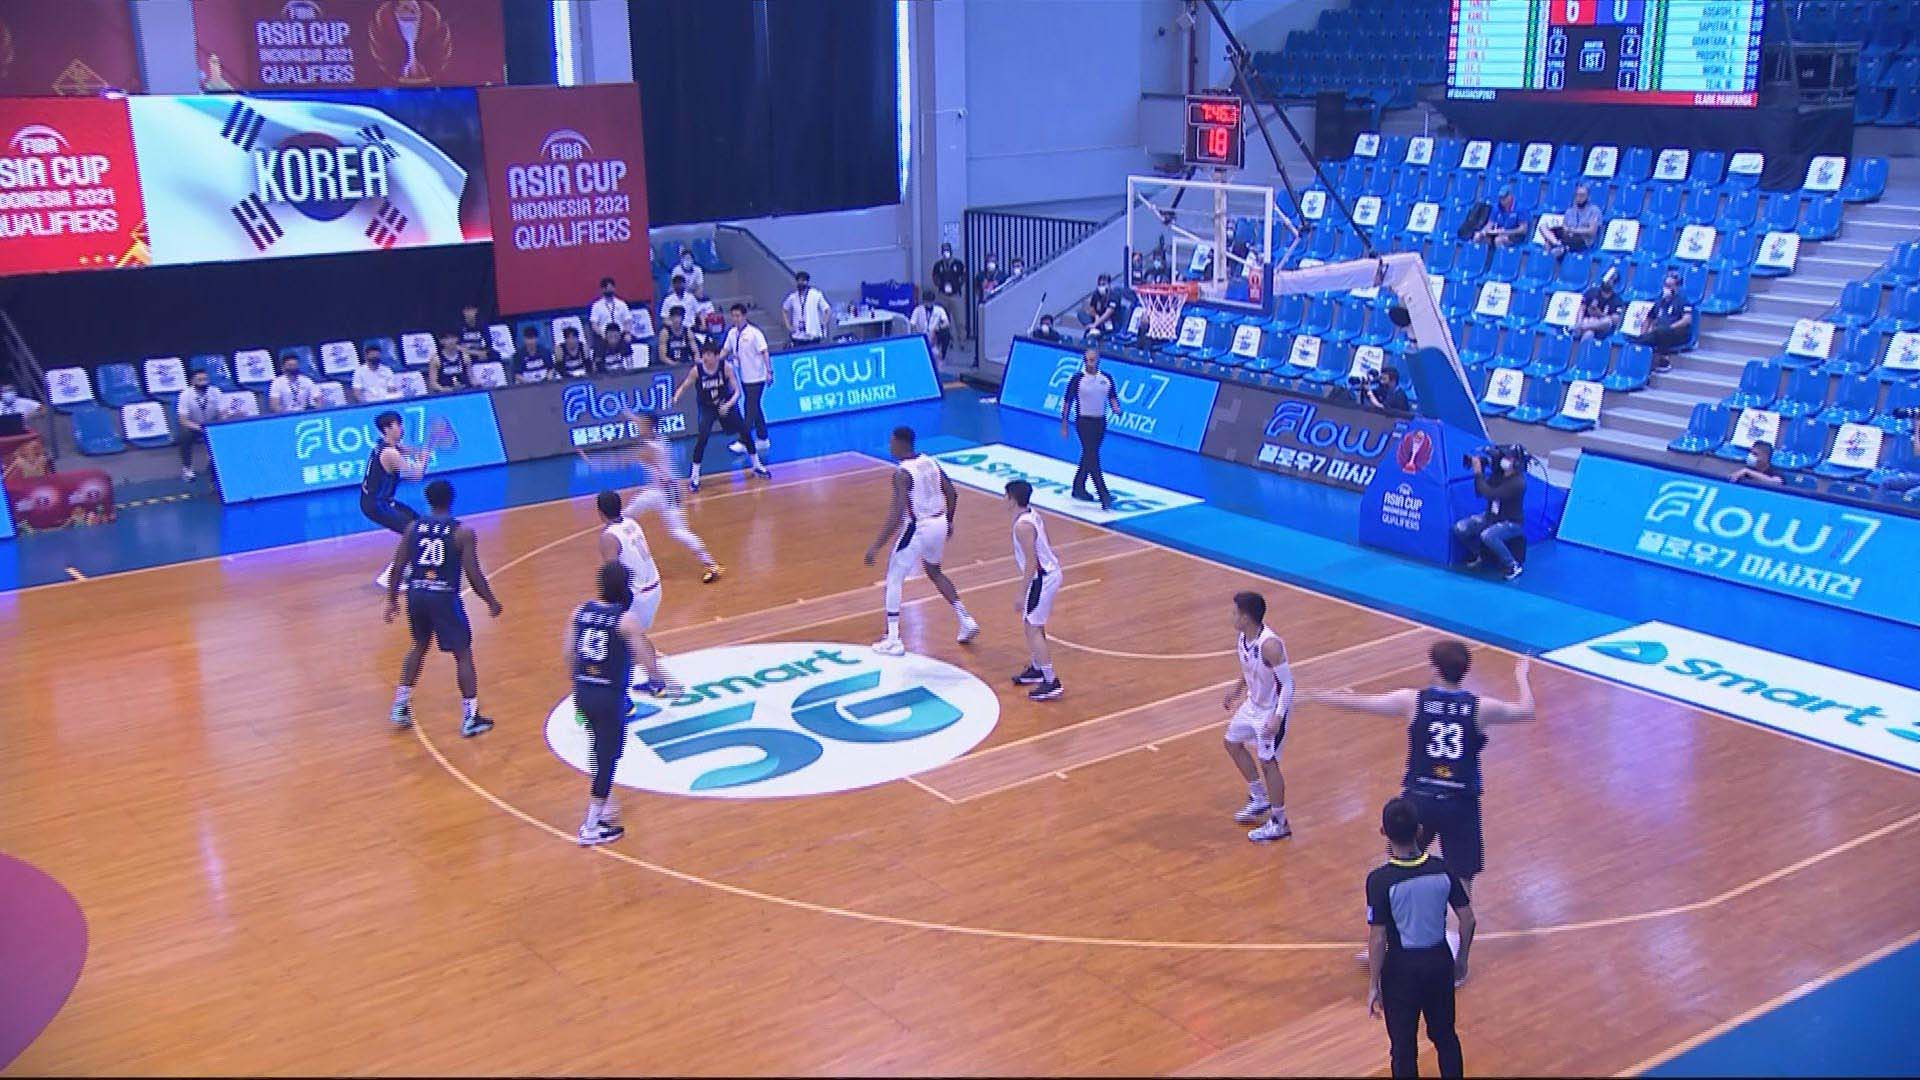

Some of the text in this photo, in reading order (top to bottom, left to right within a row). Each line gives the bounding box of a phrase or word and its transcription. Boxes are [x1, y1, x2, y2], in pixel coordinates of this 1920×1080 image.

[256, 21, 350, 45] ASIA CUP
[1554, 39, 1562, 54] 2
[1627, 38, 1635, 54] 2
[258, 48, 354, 62] INDONESIA 2021
[1585, 53, 1601, 69] 1ST
[261, 64, 355, 83] QUALIFIERS
[1694, 92, 1752, 106] CLARK PAMPANGA
[20, 136, 60, 153] FIBA
[550, 142, 583, 160] FIBA
[0, 155, 111, 188] SIA CUP
[254, 145, 389, 202] KOREA
[507, 160, 628, 199] ASIA CUP
[0, 187, 116, 209] DONESIA 2021
[511, 194, 630, 221] INDONESIA 2021
[514, 216, 632, 250] QUALIFIERS
[791, 346, 887, 392] Flow7
[1383, 491, 1423, 511] ASIA CUP
[1645, 480, 1881, 565] Flow7
[417, 538, 445, 566] 20
[577, 626, 609, 661] 43
[1664, 658, 1888, 726] Smart
[634, 668, 965, 792] 5G
[1426, 721, 1464, 759] 33
